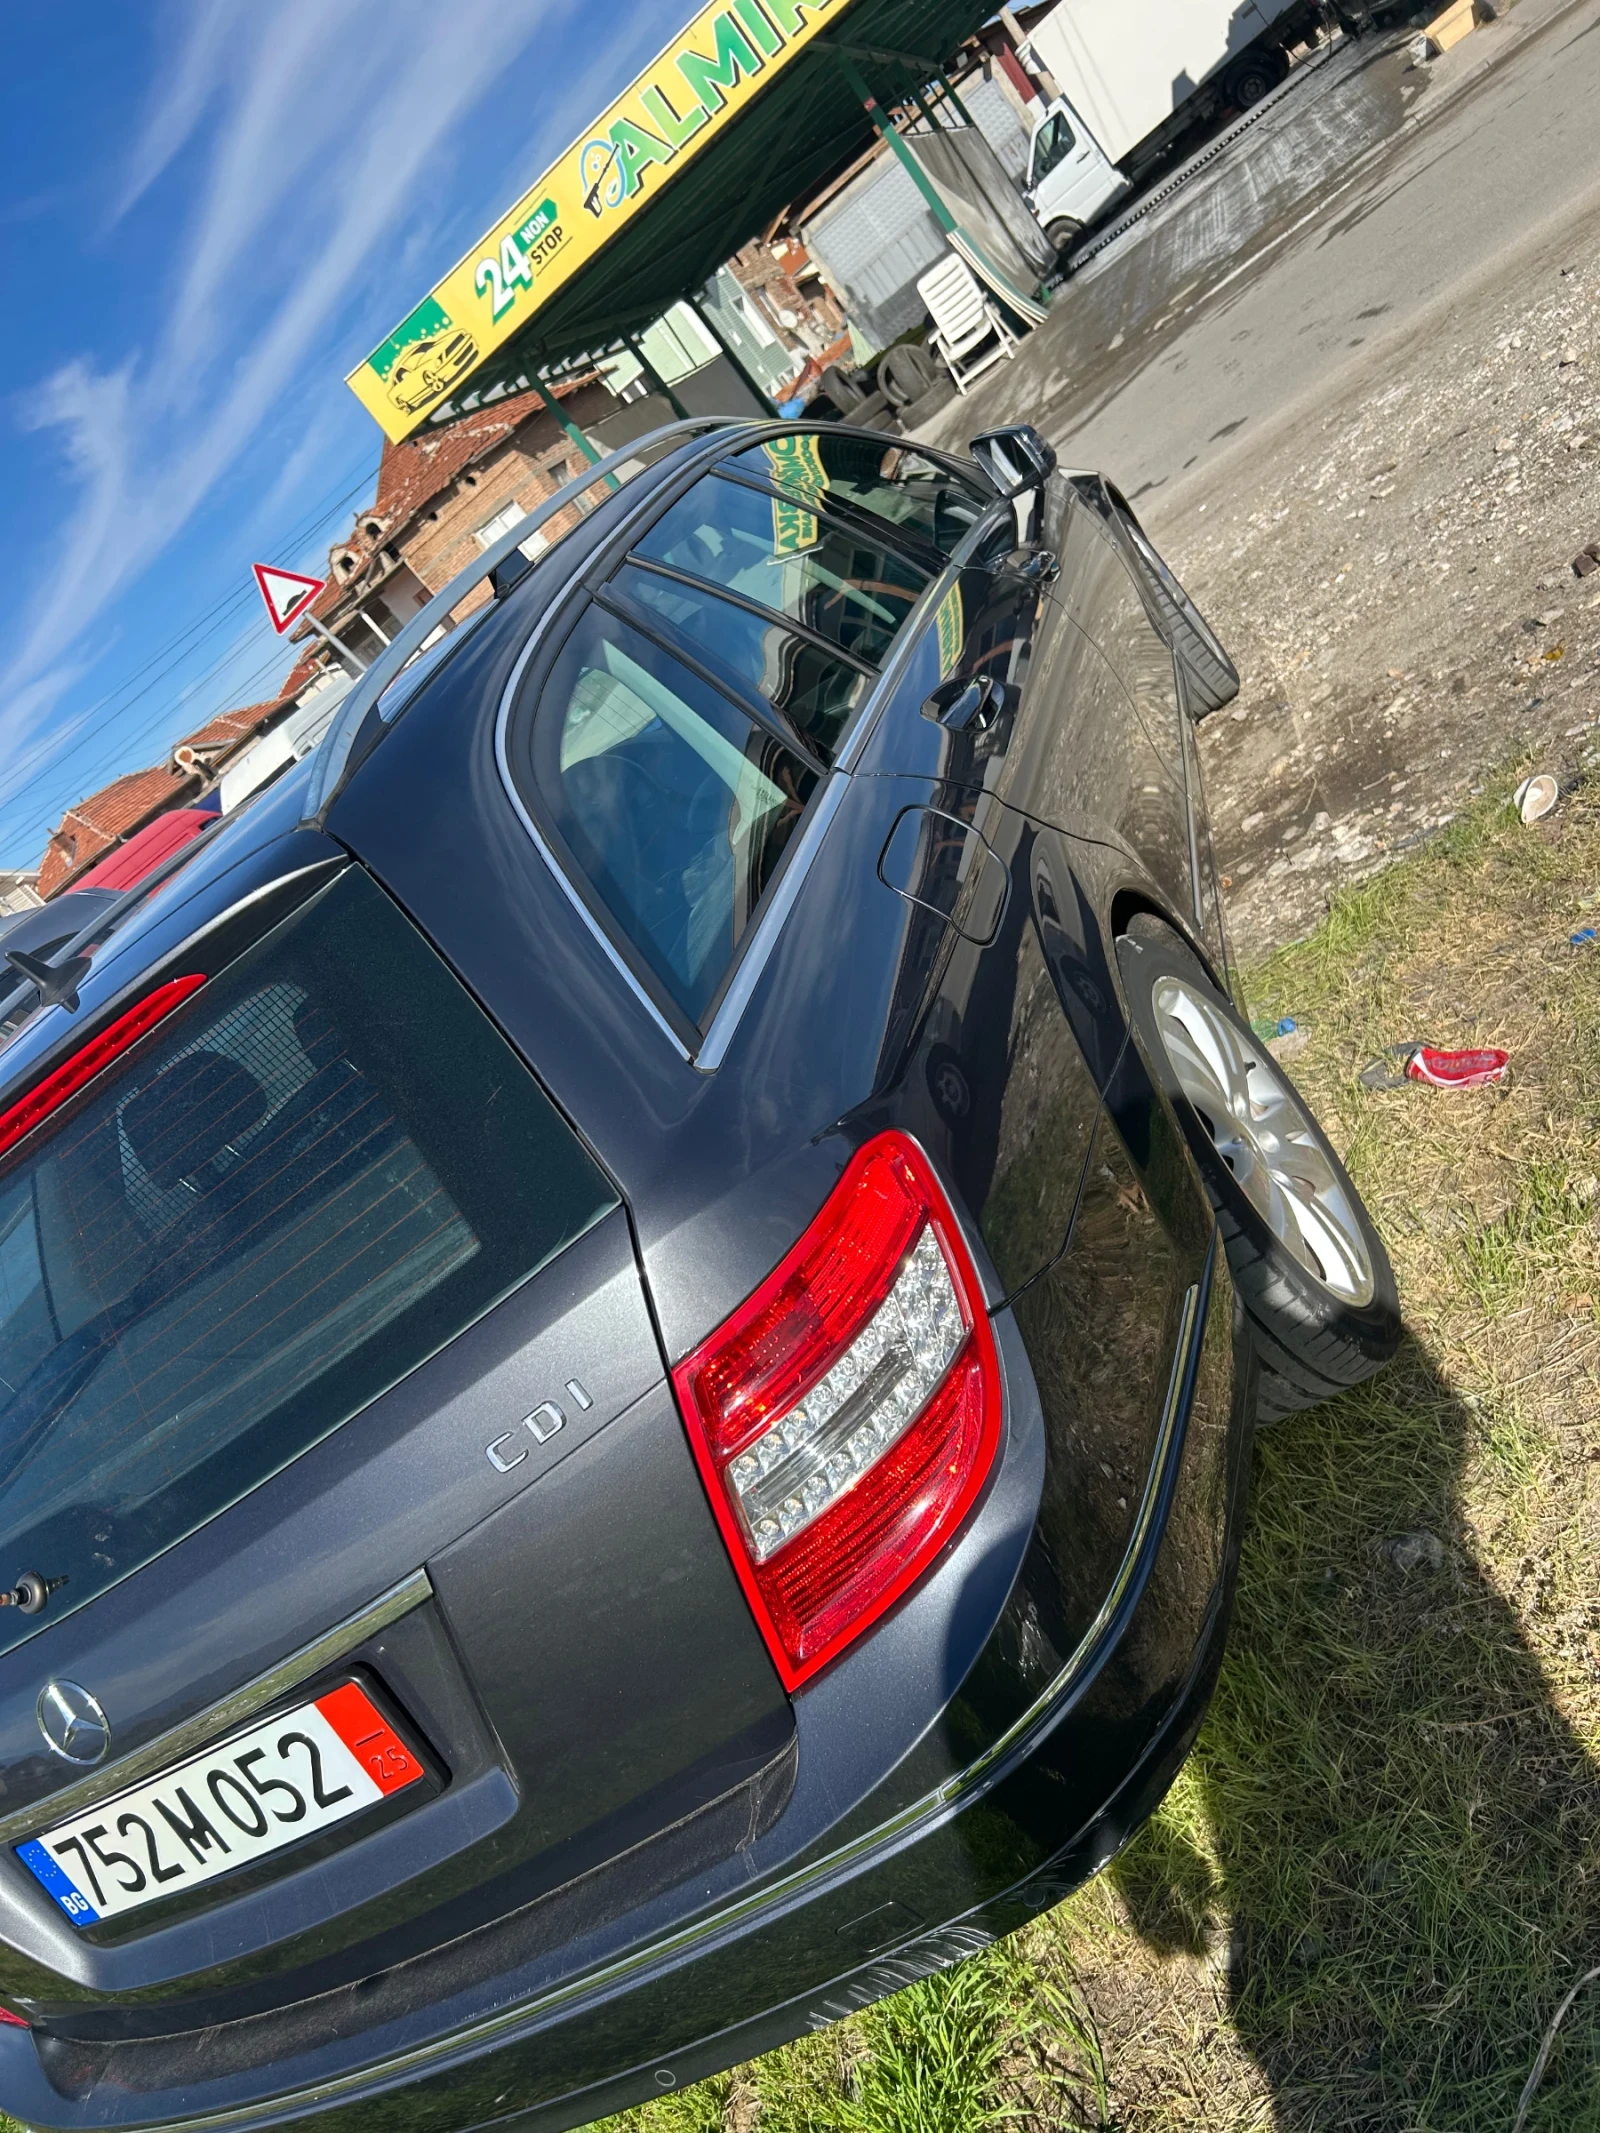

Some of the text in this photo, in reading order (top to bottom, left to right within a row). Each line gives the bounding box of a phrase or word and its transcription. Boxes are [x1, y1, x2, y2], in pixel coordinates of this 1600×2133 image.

[520, 211, 550, 244] NON
[531, 226, 563, 265] STOP
[475, 233, 533, 322] 24
[485, 1378, 593, 1474] CDI
[370, 1747, 408, 1779] 25
[60, 1891, 89, 1916] BG
